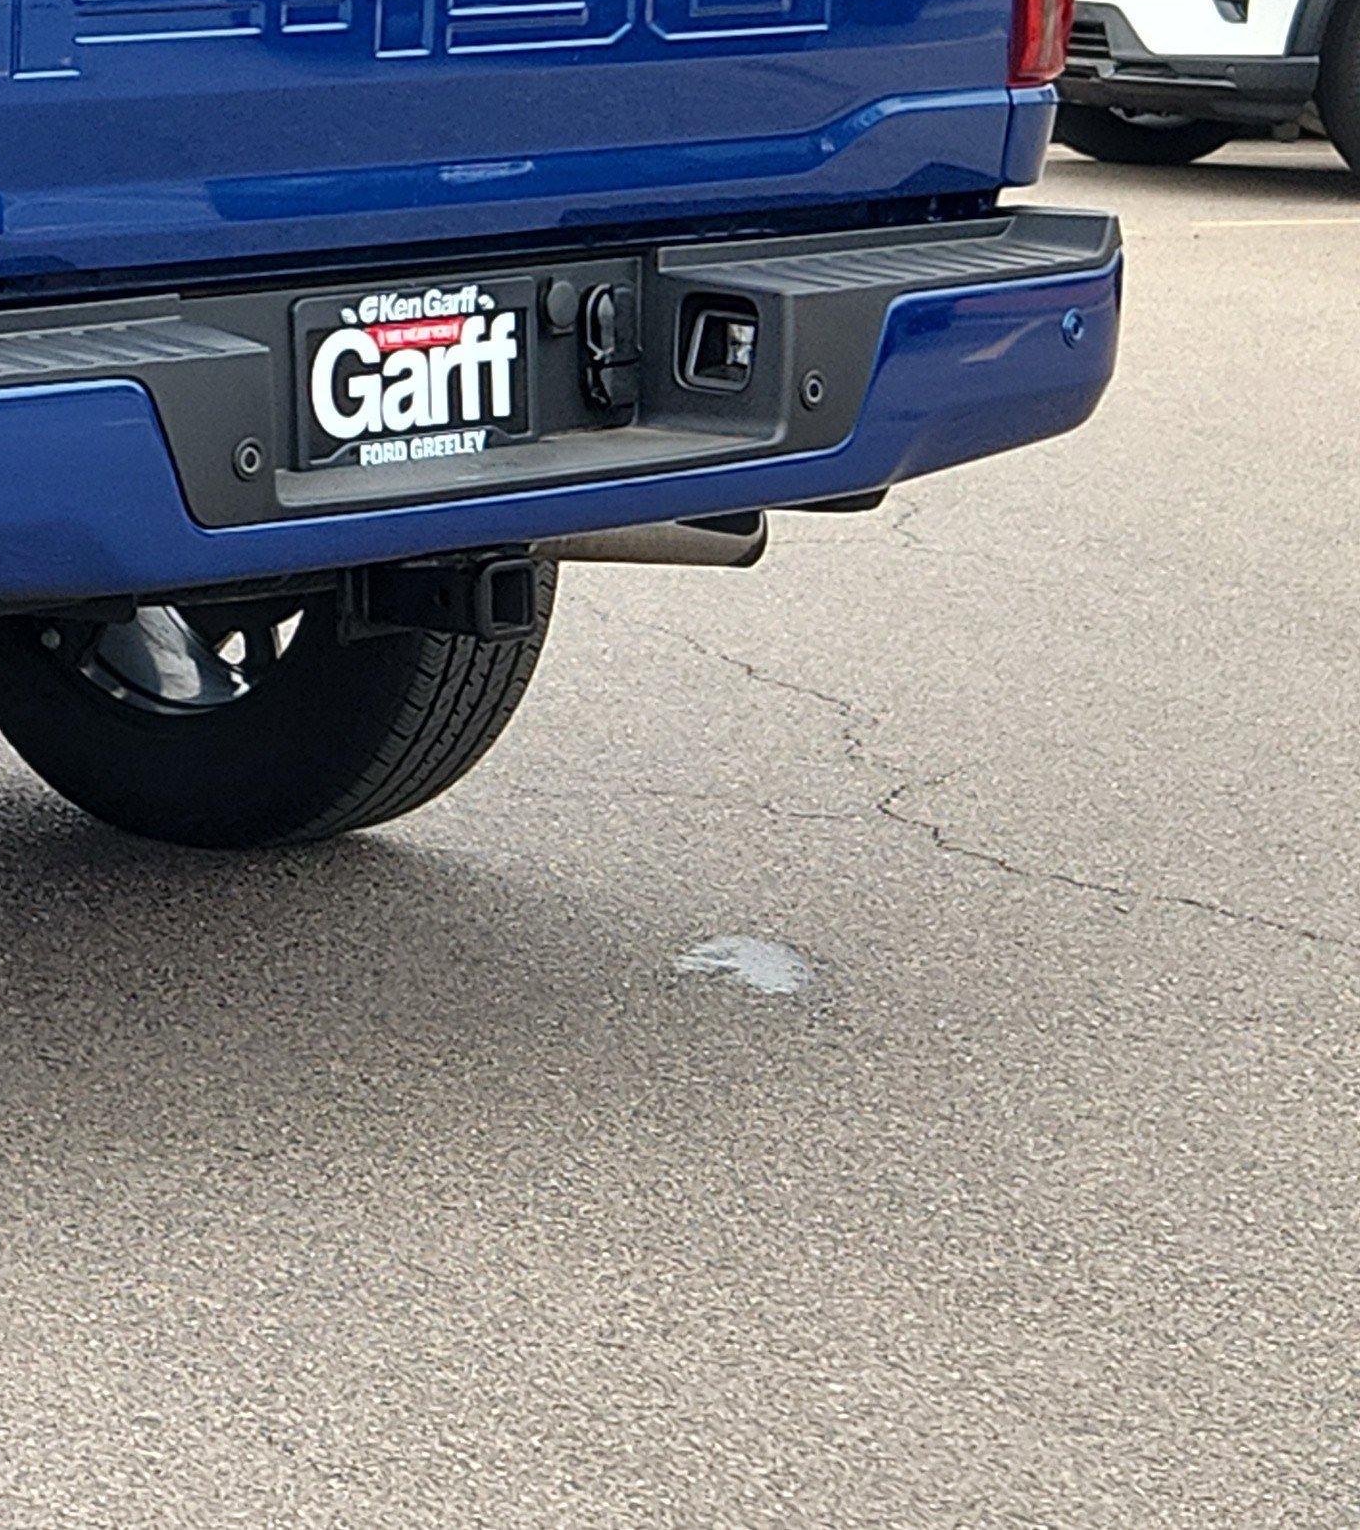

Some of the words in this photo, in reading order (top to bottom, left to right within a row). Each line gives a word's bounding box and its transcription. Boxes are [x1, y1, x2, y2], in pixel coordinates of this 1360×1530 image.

[380, 292, 422, 323] Ken
[423, 284, 478, 317] Garff
[311, 311, 518, 440] Garff
[360, 440, 408, 466] FORD
[410, 429, 487, 460] GREELEY
